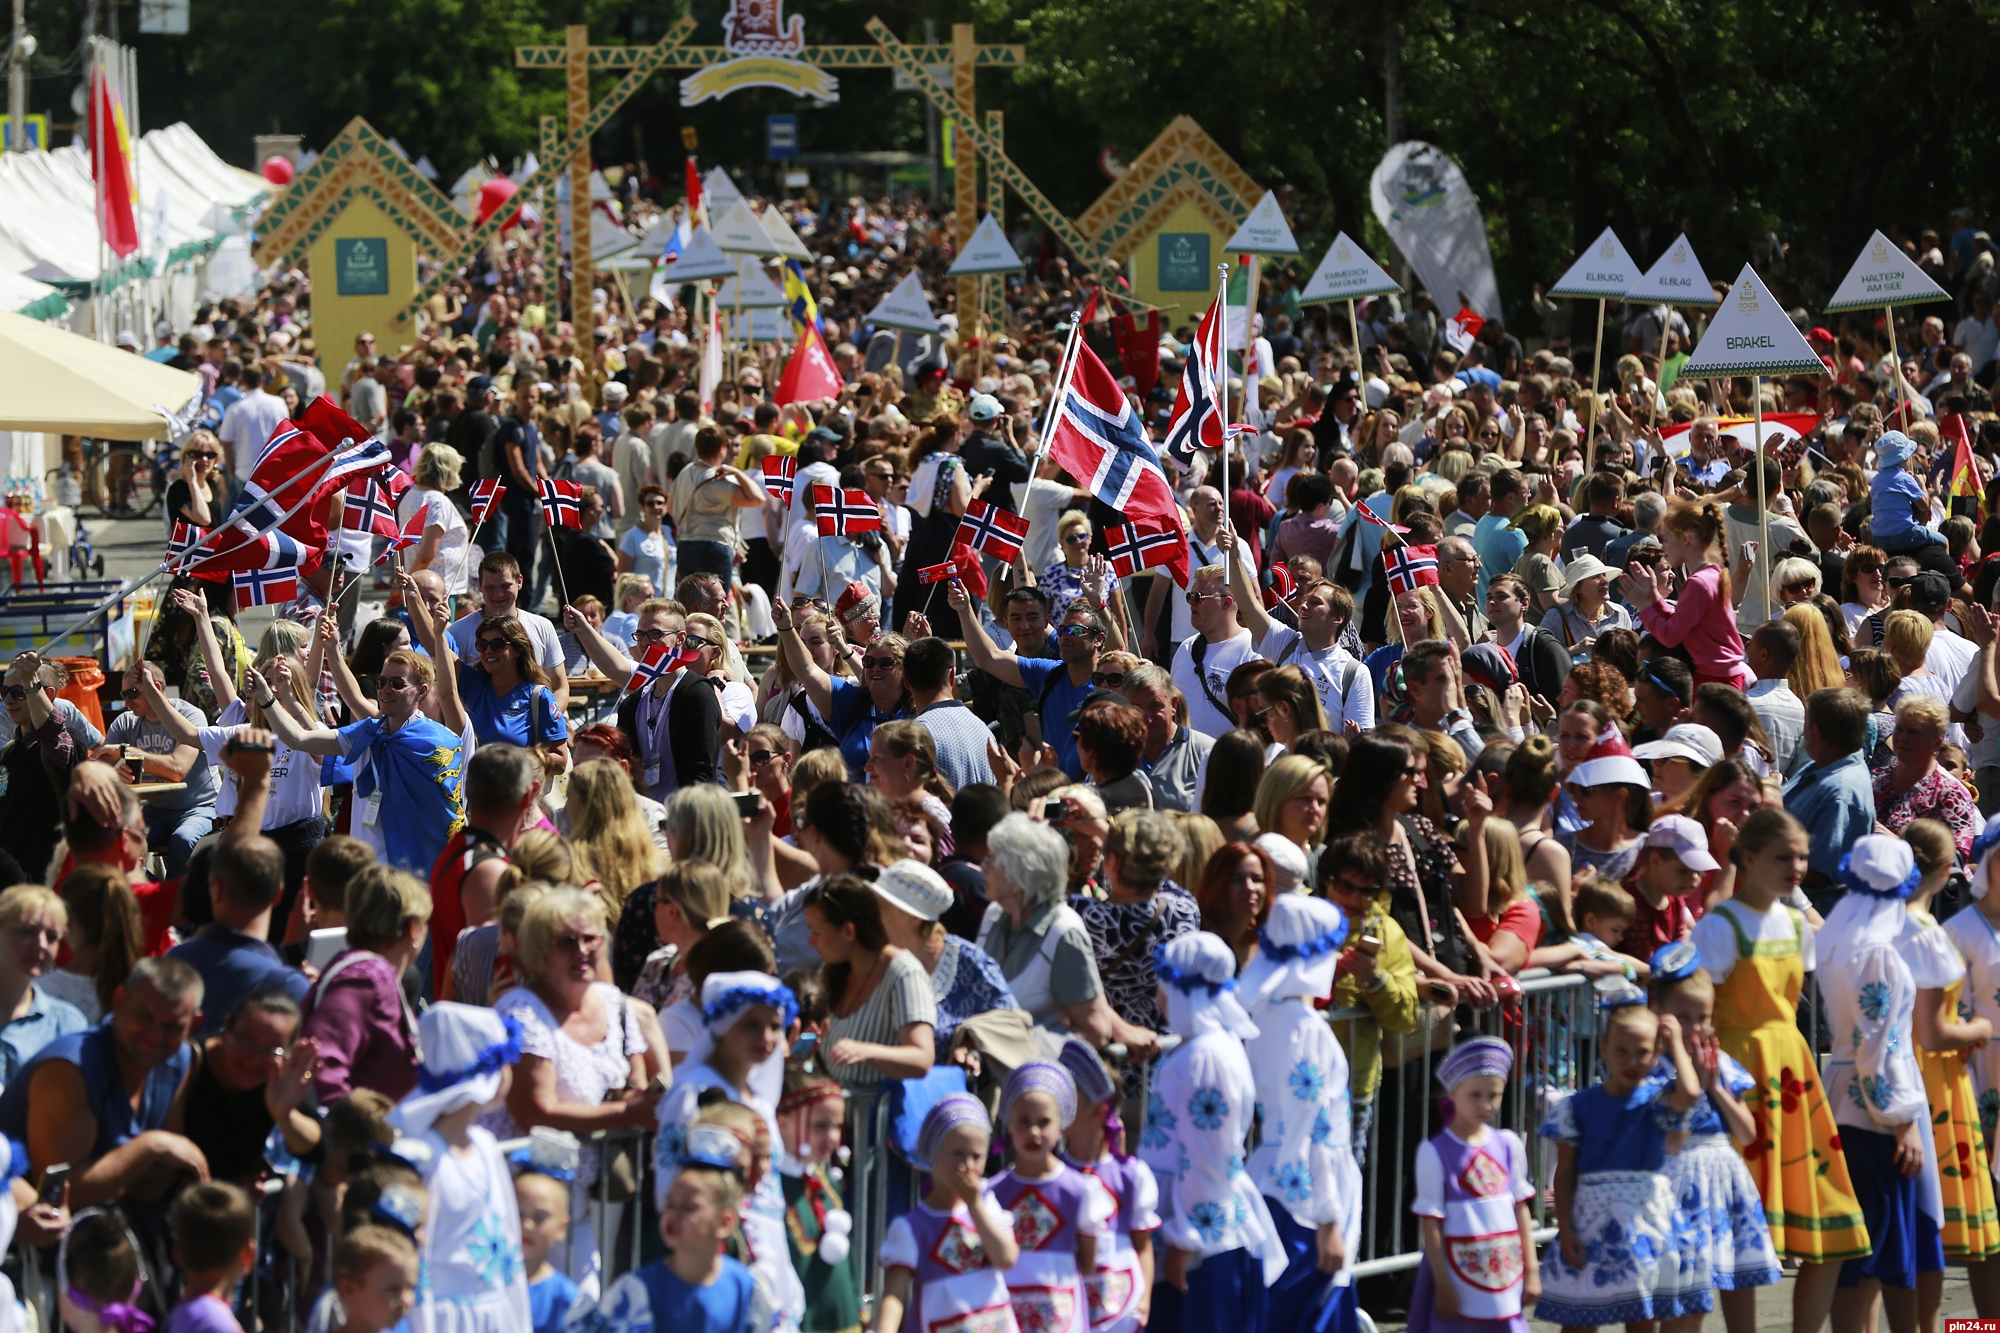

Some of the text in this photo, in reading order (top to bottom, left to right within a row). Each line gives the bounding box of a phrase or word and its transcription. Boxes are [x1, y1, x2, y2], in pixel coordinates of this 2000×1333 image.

[1324, 267, 1369, 280] EMMERICH
[1586, 272, 1624, 283] ELBURG
[1861, 271, 1905, 283] HALTERN
[1659, 275, 1692, 287] ELBLAG
[1866, 282, 1903, 293] AM SEE
[1726, 335, 1775, 349] BRAKEL
